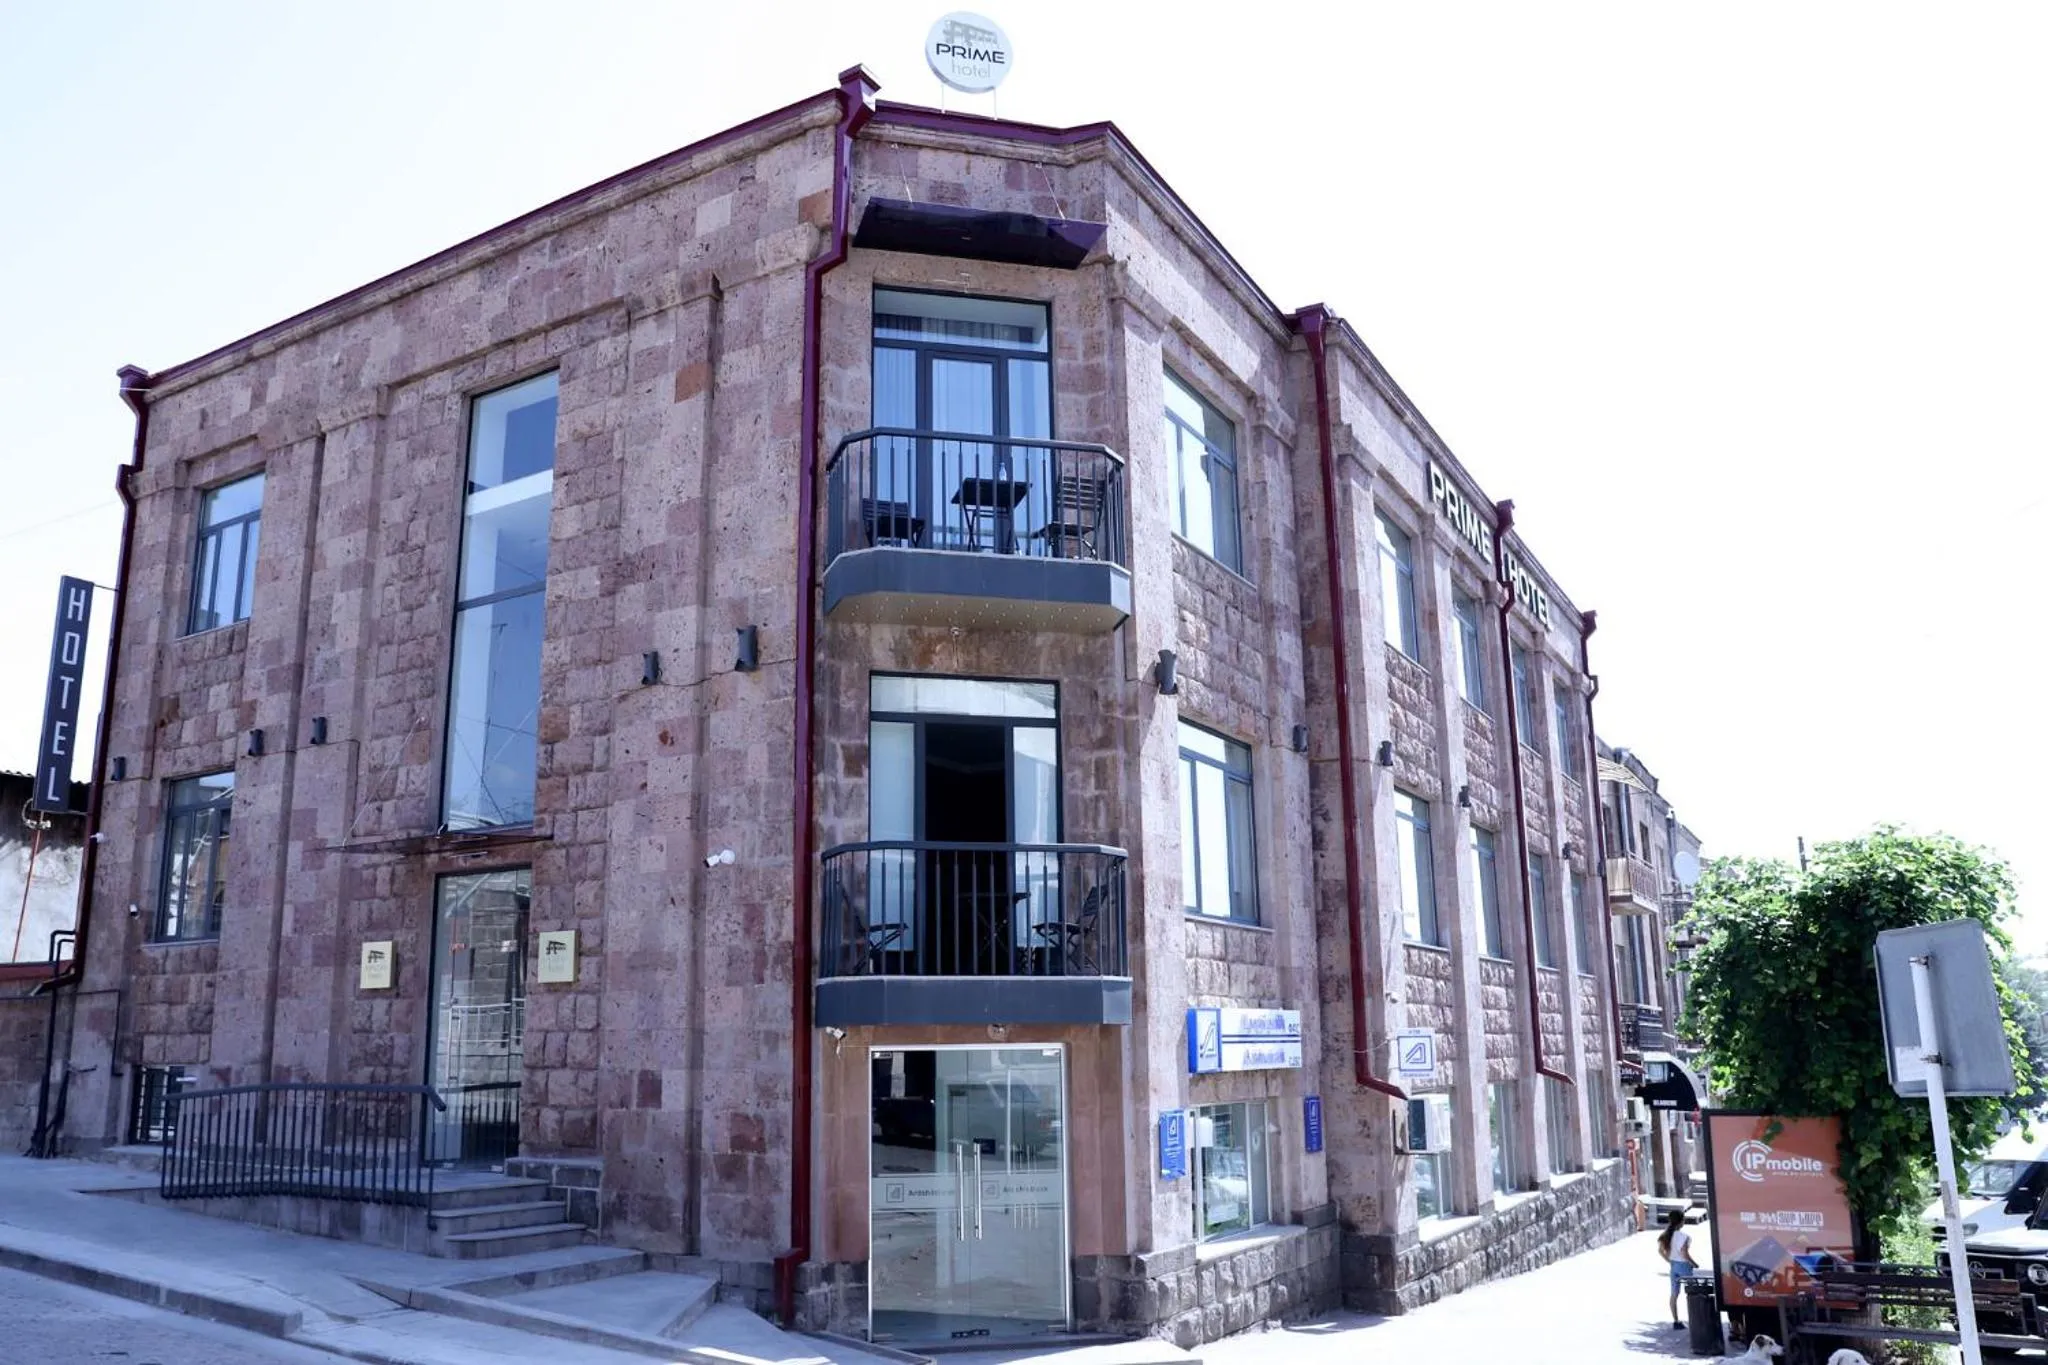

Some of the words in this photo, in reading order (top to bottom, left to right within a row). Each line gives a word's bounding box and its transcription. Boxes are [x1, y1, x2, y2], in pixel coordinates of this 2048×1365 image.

[936, 43, 1005, 64] PRIME
[952, 58, 991, 78] hotel
[1426, 460, 1492, 565] PRIME
[1501, 552, 1553, 633] HOTEL
[48, 587, 86, 802] HOTEL
